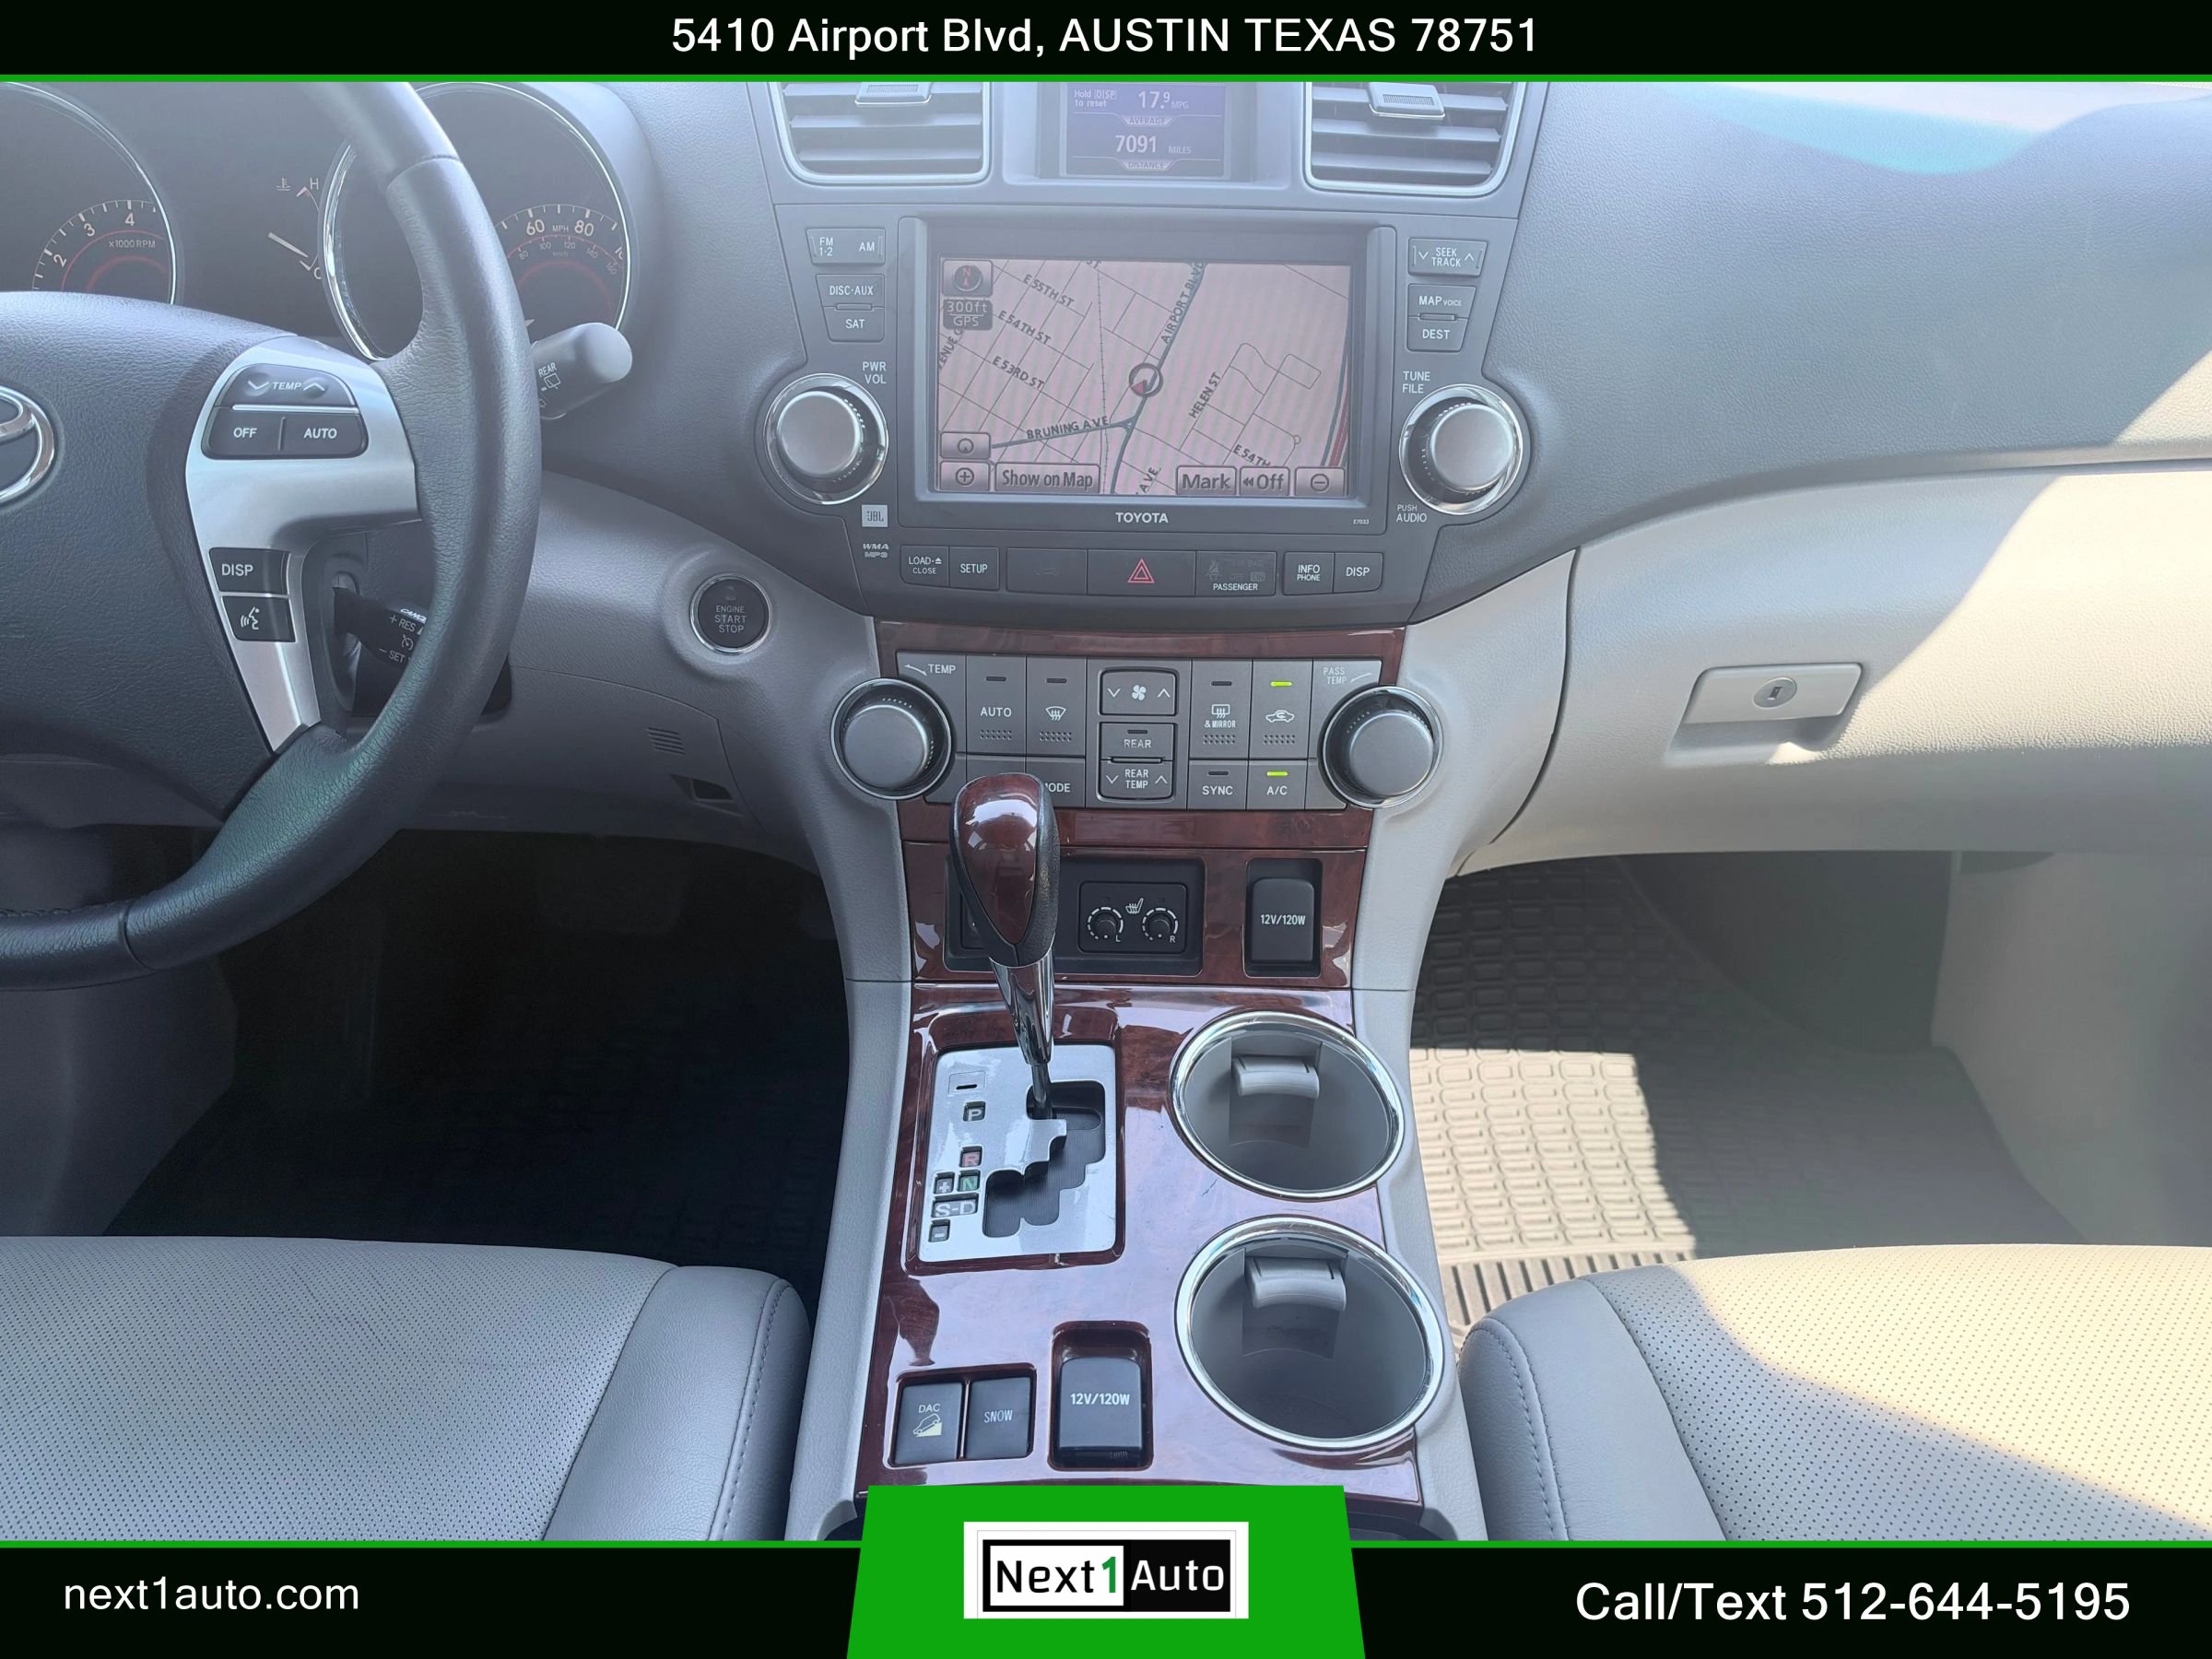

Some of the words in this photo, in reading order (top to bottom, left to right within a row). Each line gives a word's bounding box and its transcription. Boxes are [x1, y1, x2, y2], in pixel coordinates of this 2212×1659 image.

[1074, 89, 1091, 99] Hold
[1095, 89, 1116, 100] DISP
[1137, 90, 1171, 110] 17.9
[1171, 100, 1189, 109] MPG
[1129, 117, 1166, 125] AVERAGE
[1115, 135, 1157, 153] 7091
[1168, 146, 1192, 154] MILES
[1128, 161, 1164, 170] DISTANCE
[310, 177, 319, 190] H
[124, 213, 135, 227] 4
[83, 222, 96, 237] 3
[526, 218, 546, 236] 60
[574, 219, 594, 237] 80
[539, 241, 552, 251] 100
[564, 241, 576, 250] 120
[819, 236, 834, 246] FM
[858, 241, 876, 252] AM
[1435, 247, 1458, 257] SEEK
[53, 253, 67, 267] 2
[1431, 257, 1462, 267] TRACK
[1022, 274, 1033, 284] E
[1030, 278, 1059, 301] 55TH
[1059, 295, 1075, 308] ST
[1418, 295, 1442, 306] MAP
[947, 300, 988, 313] 300ft
[845, 318, 865, 329] SAT
[953, 316, 980, 326] GPS
[1160, 291, 1190, 345] AIRPORT
[997, 310, 1007, 320] E
[1006, 314, 1036, 336] 54TH
[1035, 332, 1052, 345] ST
[1422, 328, 1451, 340] DEST
[537, 362, 558, 378] REAR
[862, 360, 887, 371] PWR
[865, 373, 887, 384] VOL
[992, 356, 1003, 366] E
[1001, 360, 1030, 382] 53RD
[1029, 377, 1046, 390] ST
[1403, 371, 1431, 382] TUNE
[272, 382, 302, 390] TEMP
[1402, 383, 1424, 394] FILE
[1188, 385, 1216, 418] HELEN
[1208, 371, 1221, 387] ST
[233, 427, 258, 439] OFF
[1027, 421, 1079, 440] BRUNING
[1083, 416, 1109, 430] AVE
[303, 428, 337, 440] AUTO
[1232, 444, 1242, 454] E
[1002, 469, 1041, 487] Show
[1043, 474, 1060, 487] on
[1063, 472, 1093, 491] Map
[1182, 473, 1232, 490] Mark
[1256, 473, 1285, 490] Off
[1397, 503, 1418, 512] PUSH
[866, 510, 885, 522] JBL
[1114, 512, 1170, 524] TOYOTA
[1395, 512, 1428, 524] AUDIO
[221, 563, 253, 577] DISP
[959, 563, 988, 574] SETUP
[1298, 564, 1321, 574] INFO
[1346, 567, 1371, 577] DISP
[1212, 582, 1259, 591] PASSENGER
[715, 605, 746, 614] ENGINE
[714, 614, 747, 624] START
[398, 618, 417, 632] RES
[718, 624, 745, 633] STOP
[388, 650, 406, 663] SET
[927, 664, 957, 674] TEMP
[1323, 666, 1346, 676] PASS
[1326, 677, 1347, 685] TEMP
[980, 706, 1012, 718] AUTO
[1211, 720, 1236, 729] MIRROR
[1124, 738, 1152, 748] REAR
[1124, 769, 1149, 778] REAR
[1044, 782, 1071, 793] ODE
[1124, 780, 1148, 789] TEMP
[1202, 785, 1233, 796] SYNC
[1266, 785, 1288, 796] A/C
[1260, 913, 1306, 926] 12V/120W
[1115, 935, 1122, 943] L
[1169, 935, 1176, 944] R
[967, 1108, 982, 1122] P
[962, 1153, 979, 1167] R
[962, 1178, 978, 1192] N
[1070, 1393, 1130, 1406] 12V/120W
[918, 1403, 942, 1414] DAC
[983, 1409, 1014, 1423] SNOW
